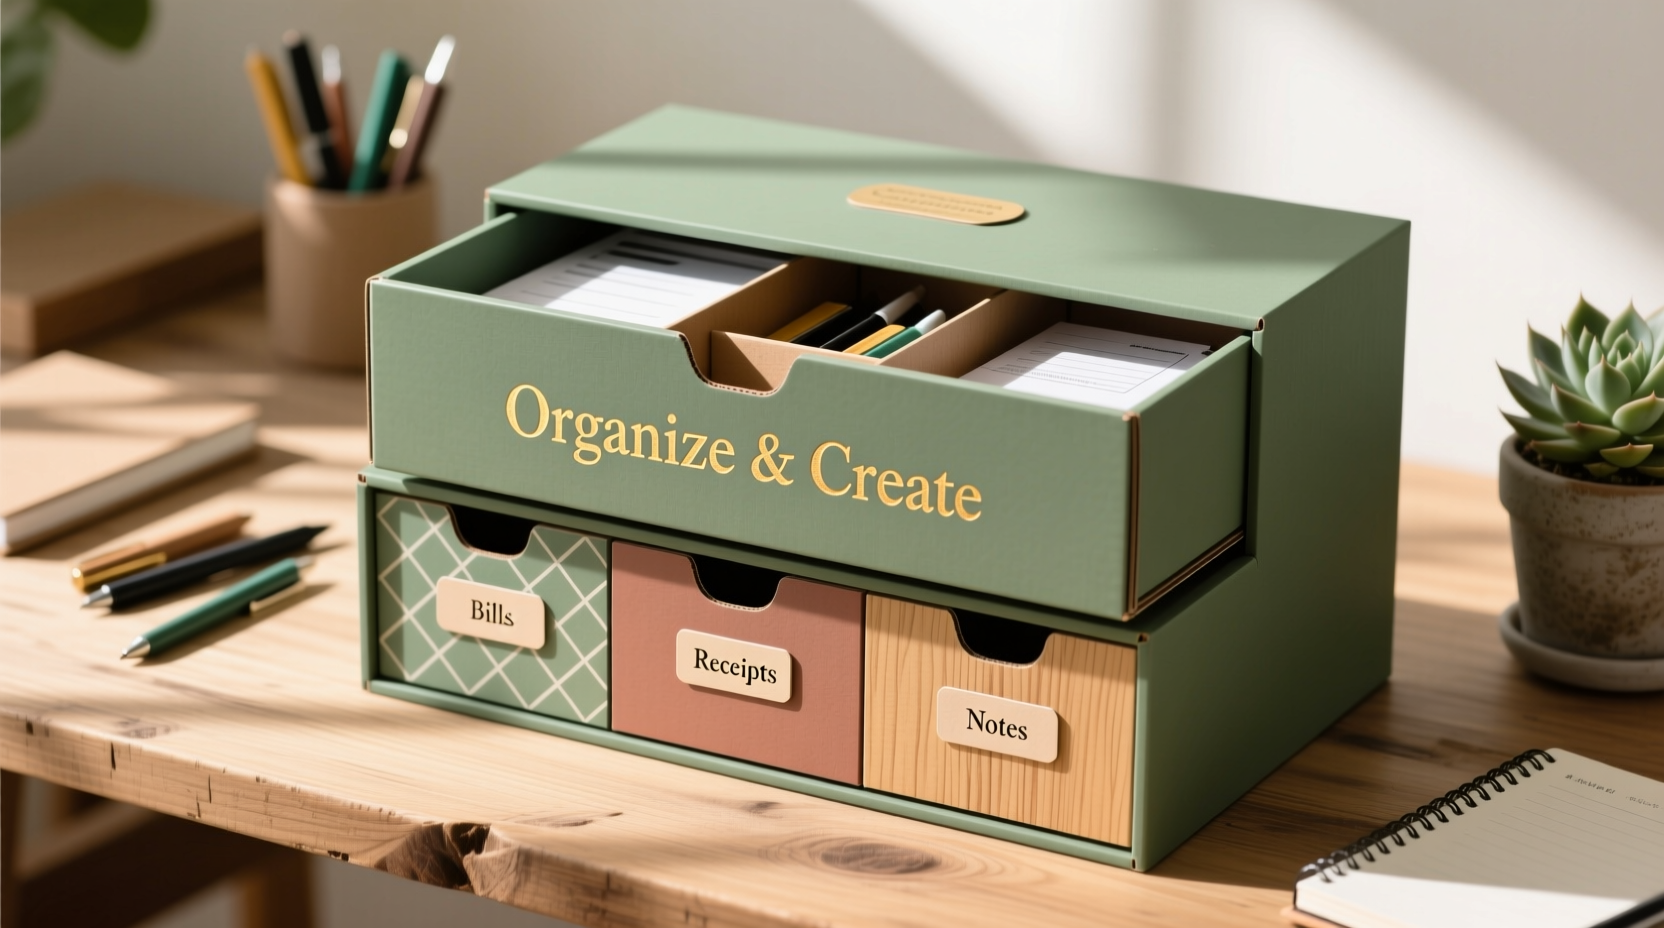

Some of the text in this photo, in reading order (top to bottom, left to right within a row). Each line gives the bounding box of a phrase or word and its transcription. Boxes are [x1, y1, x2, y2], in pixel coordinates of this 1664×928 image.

[505, 383, 983, 523] Organize & Create
[470, 598, 515, 627] Bills
[693, 647, 778, 686] Receipts
[966, 707, 1028, 741] Notes
